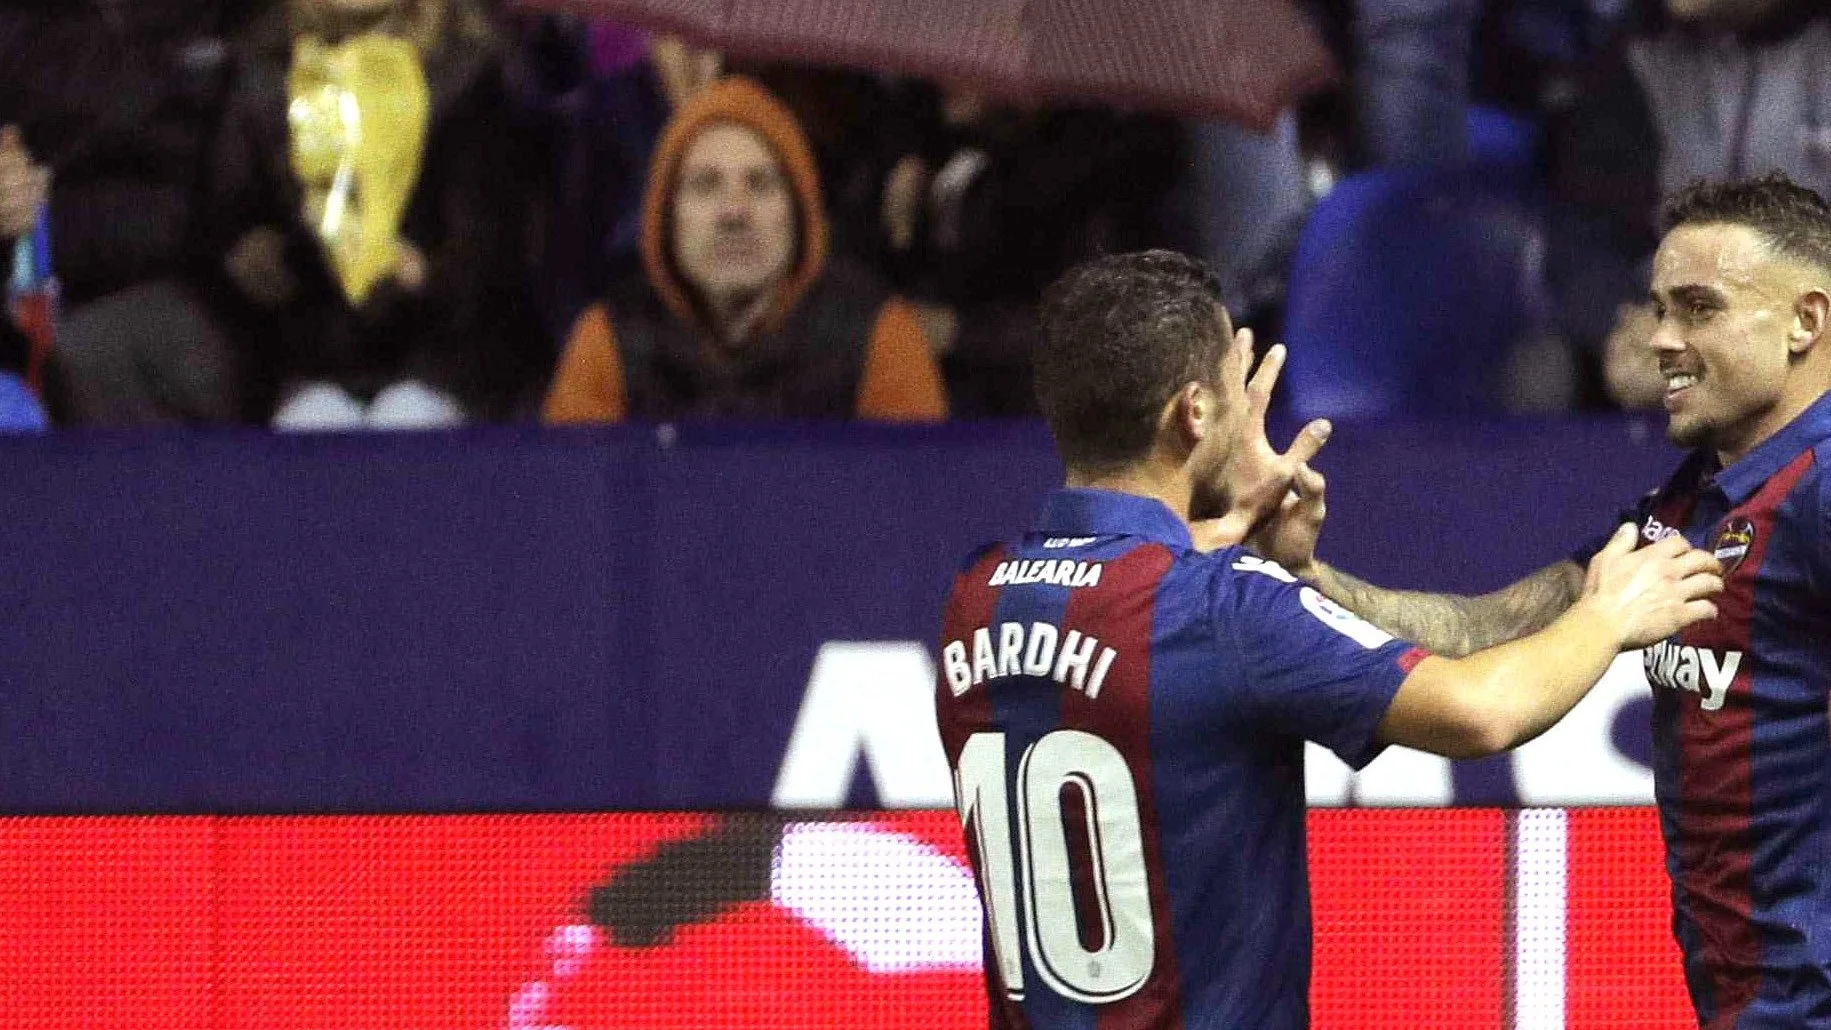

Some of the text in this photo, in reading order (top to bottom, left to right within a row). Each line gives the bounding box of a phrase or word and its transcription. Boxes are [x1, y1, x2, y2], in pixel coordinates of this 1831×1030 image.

[988, 559, 1102, 587] BALEARIA
[943, 621, 1117, 699] BARDHI
[953, 729, 1156, 1004] 10
